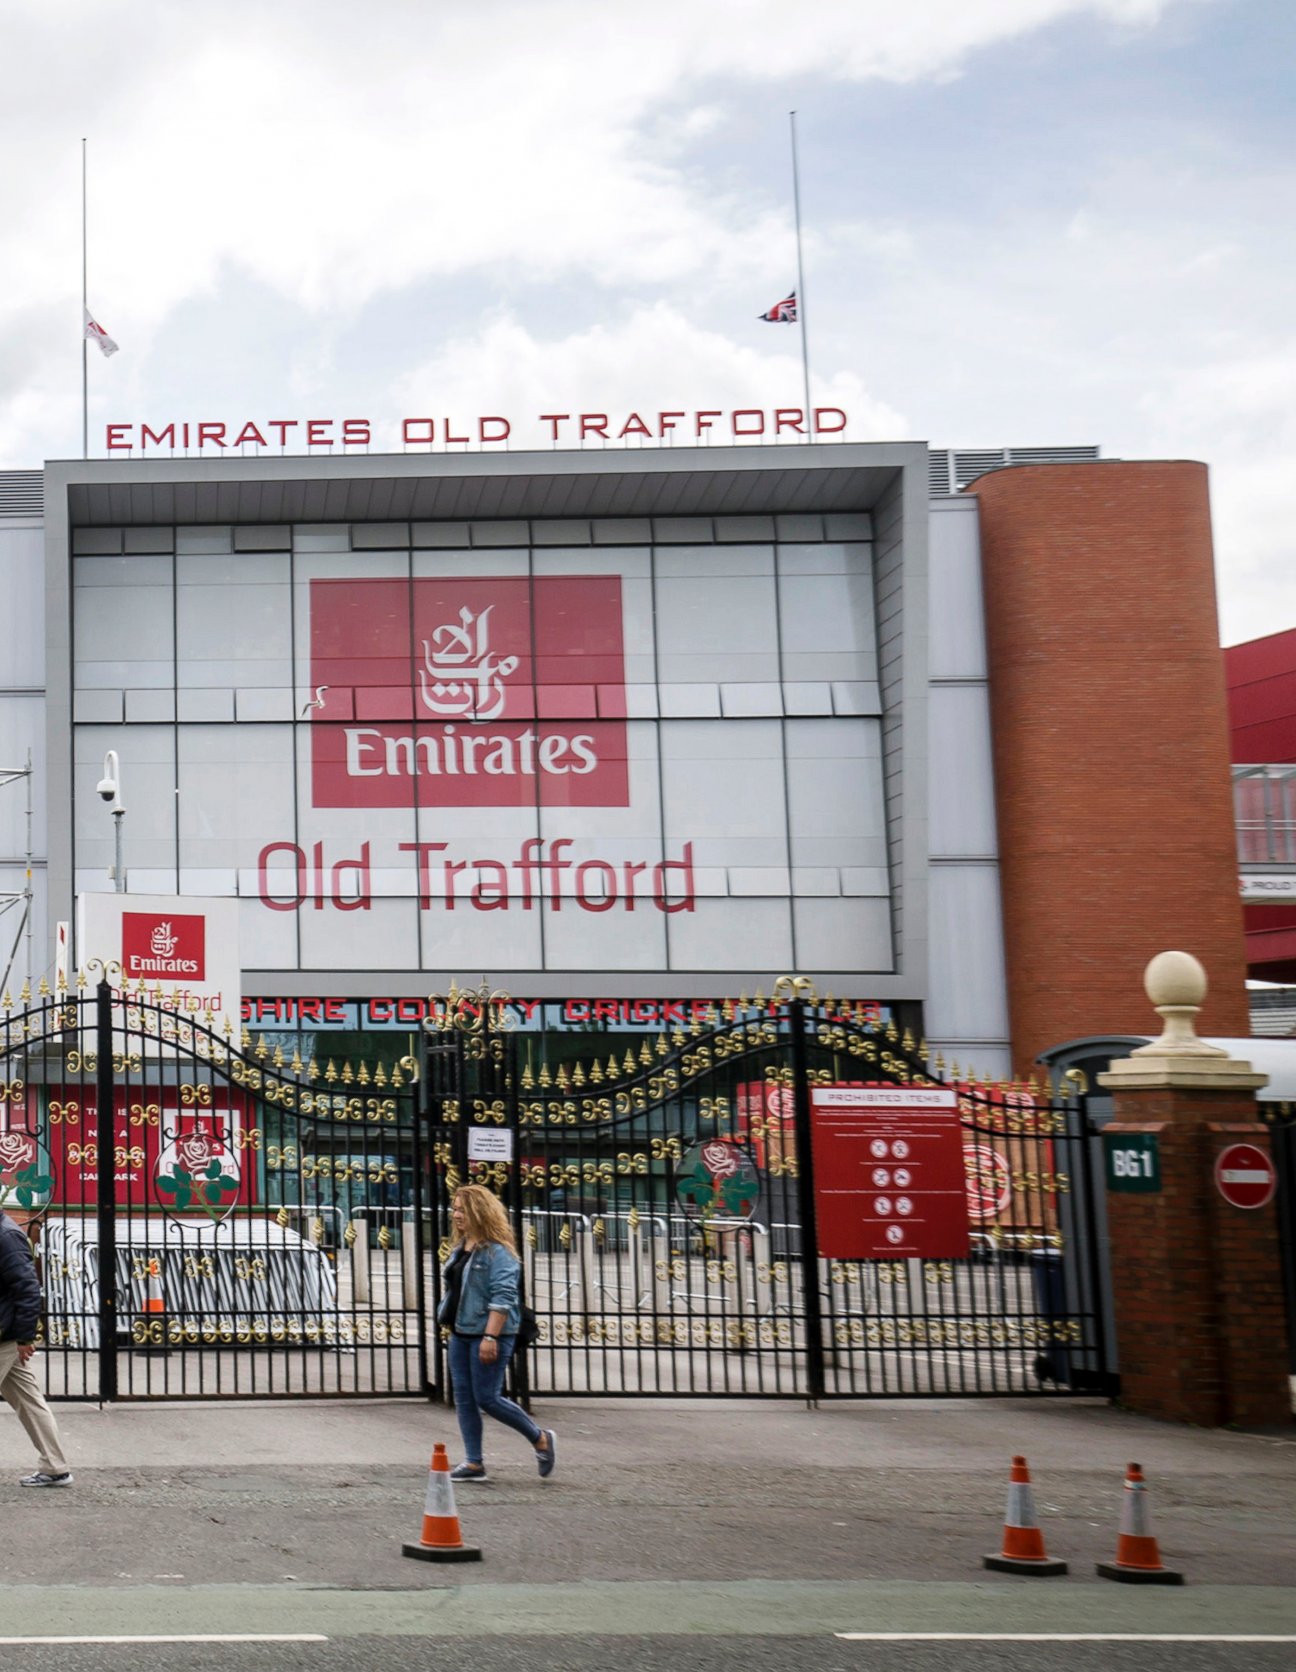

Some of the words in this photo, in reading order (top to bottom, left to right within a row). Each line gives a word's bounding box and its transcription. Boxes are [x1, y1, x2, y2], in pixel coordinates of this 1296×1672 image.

[106, 419, 371, 449] EMIRATES
[403, 416, 511, 444] OLD
[539, 408, 847, 440] TRAFFORD
[343, 724, 599, 777] Emirates
[257, 840, 372, 912] Old
[398, 838, 696, 914] Trafford
[129, 955, 198, 973] Emirates
[828, 1093, 902, 1103] PROHIBITED
[906, 1094, 941, 1103] ITEMS
